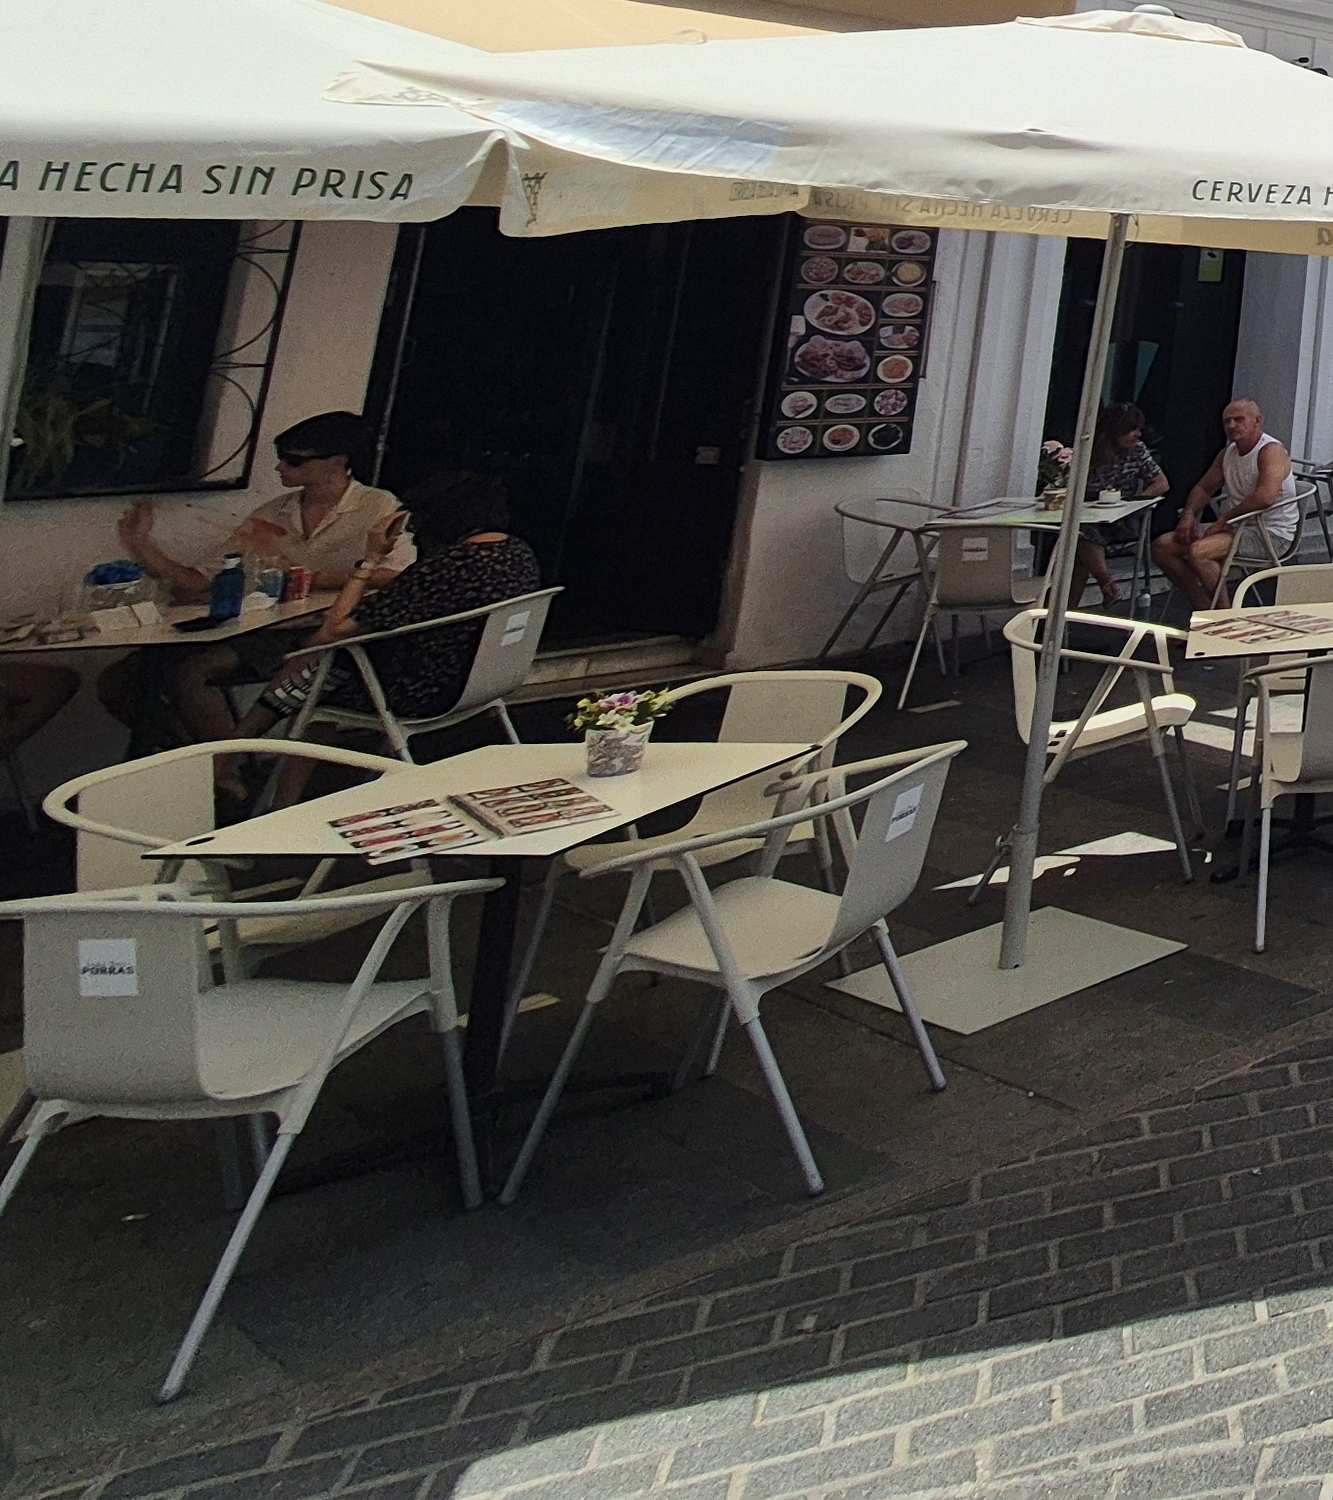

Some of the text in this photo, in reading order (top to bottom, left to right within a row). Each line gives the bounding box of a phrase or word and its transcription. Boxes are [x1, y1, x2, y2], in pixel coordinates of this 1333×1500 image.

[38, 161, 184, 194] HECHA
[201, 164, 277, 196] SIN
[290, 168, 414, 202] PRISA
[1191, 179, 1313, 206] CERVEZA
